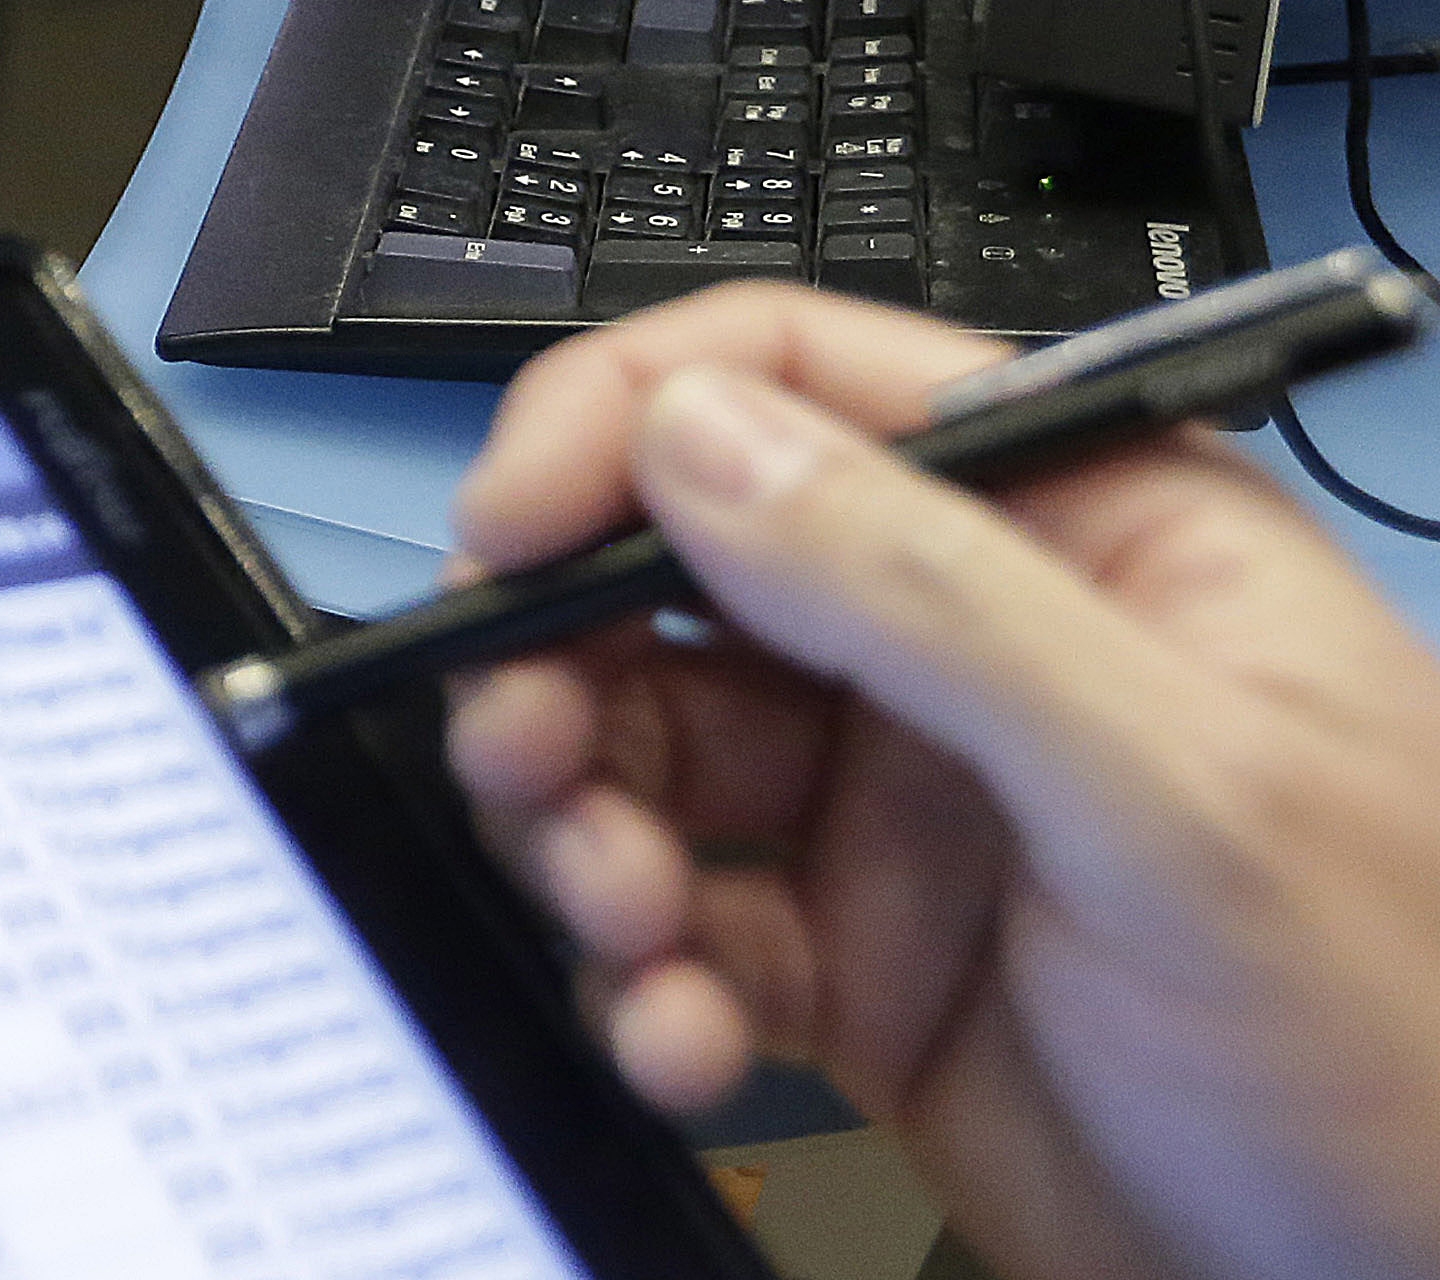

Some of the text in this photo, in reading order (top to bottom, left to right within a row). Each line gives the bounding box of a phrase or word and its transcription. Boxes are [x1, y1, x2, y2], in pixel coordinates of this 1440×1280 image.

[450, 147, 479, 161] 0
[551, 150, 582, 160] 1
[657, 150, 688, 166] 4
[765, 148, 796, 161] 7
[548, 178, 578, 194] 2
[652, 182, 683, 198] 5
[761, 178, 794, 190] 8
[540, 212, 572, 226] 3
[648, 213, 679, 228] 6
[762, 212, 794, 225] 9
[1146, 222, 1191, 301] lenovo
